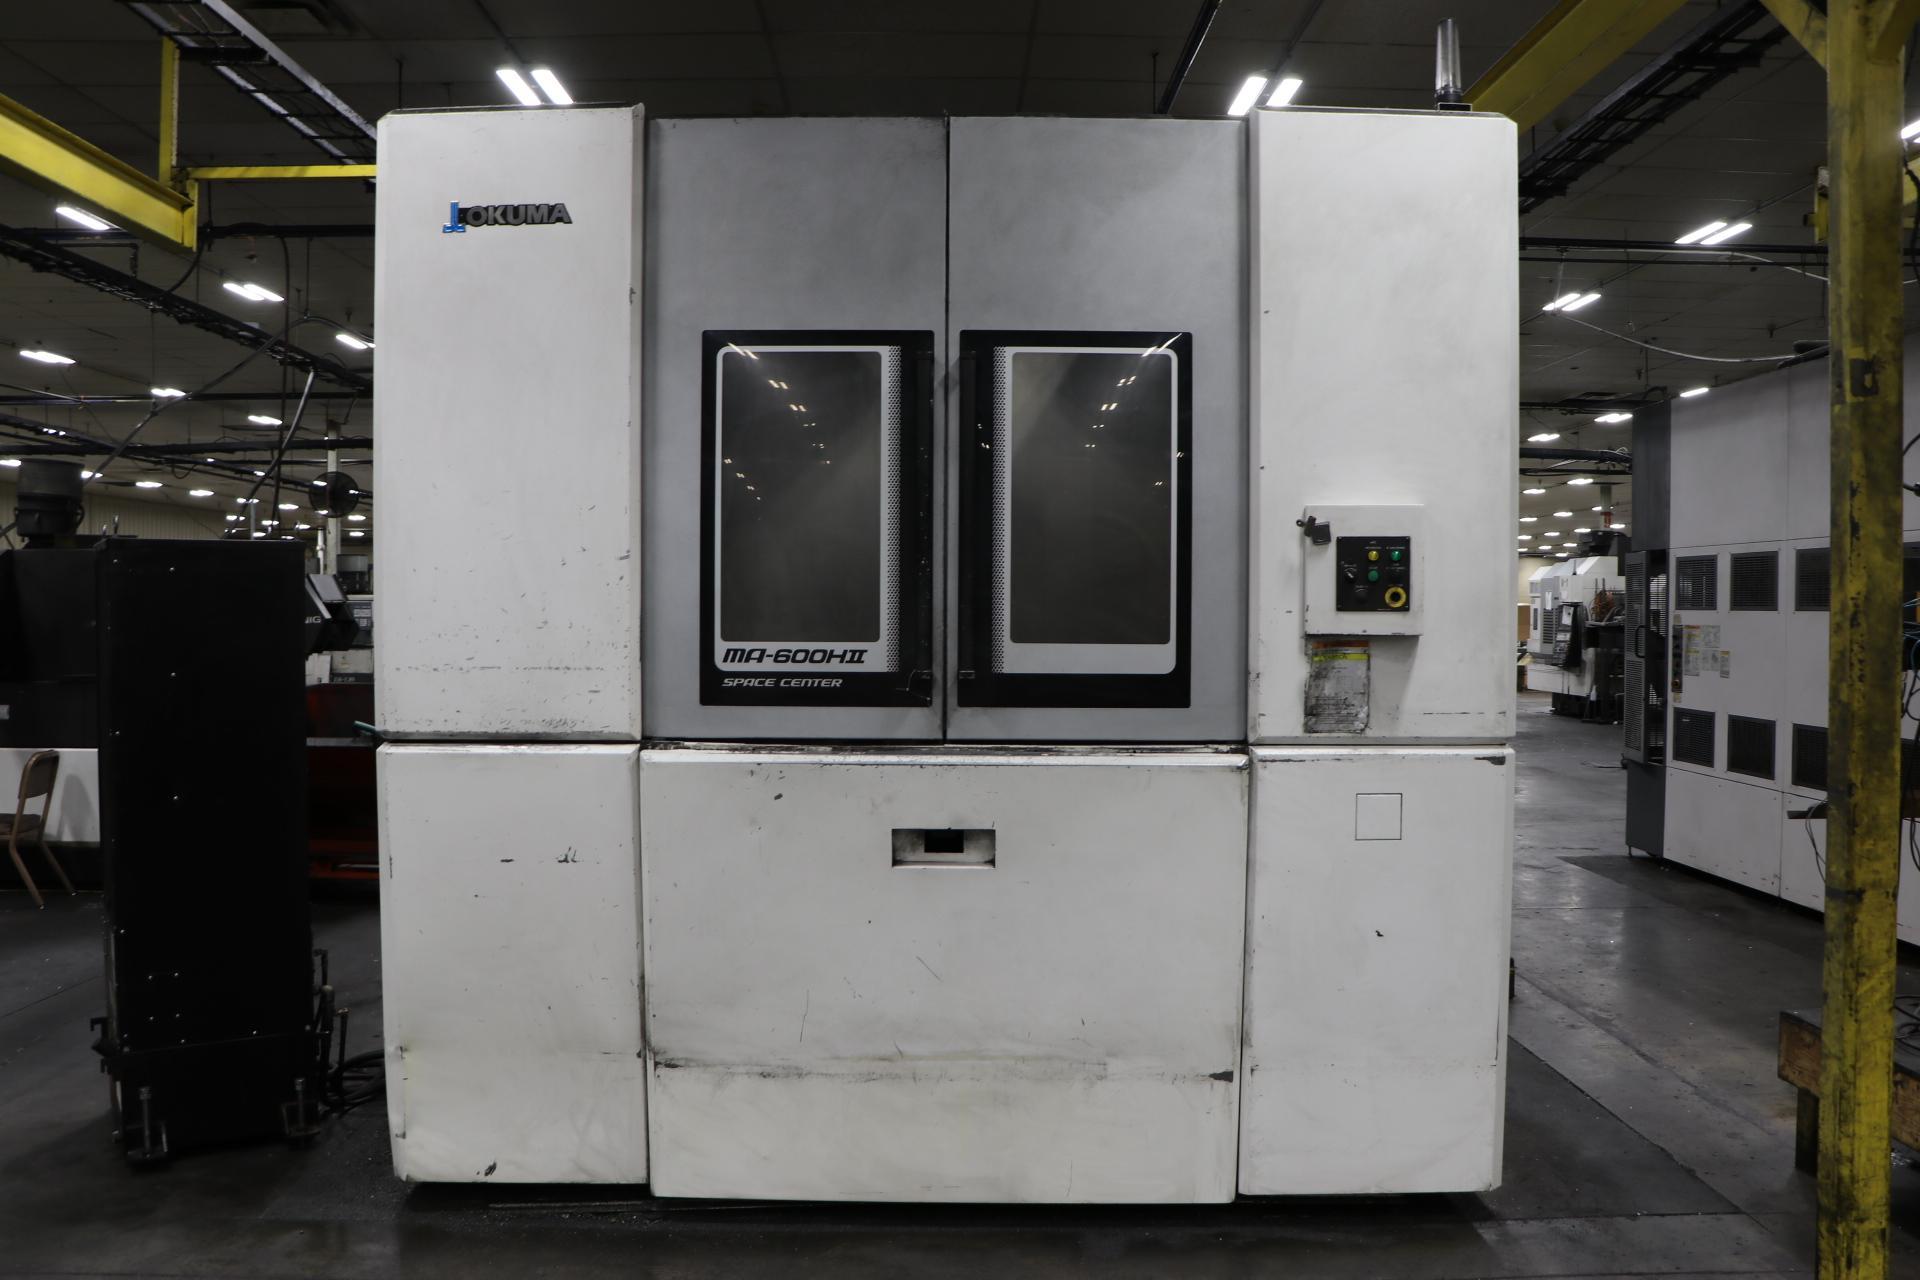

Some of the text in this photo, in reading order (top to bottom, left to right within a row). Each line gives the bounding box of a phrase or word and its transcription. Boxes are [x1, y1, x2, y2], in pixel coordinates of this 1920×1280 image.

[464, 203, 572, 227] OKUMA
[722, 678, 843, 687] SPACE CENTER
